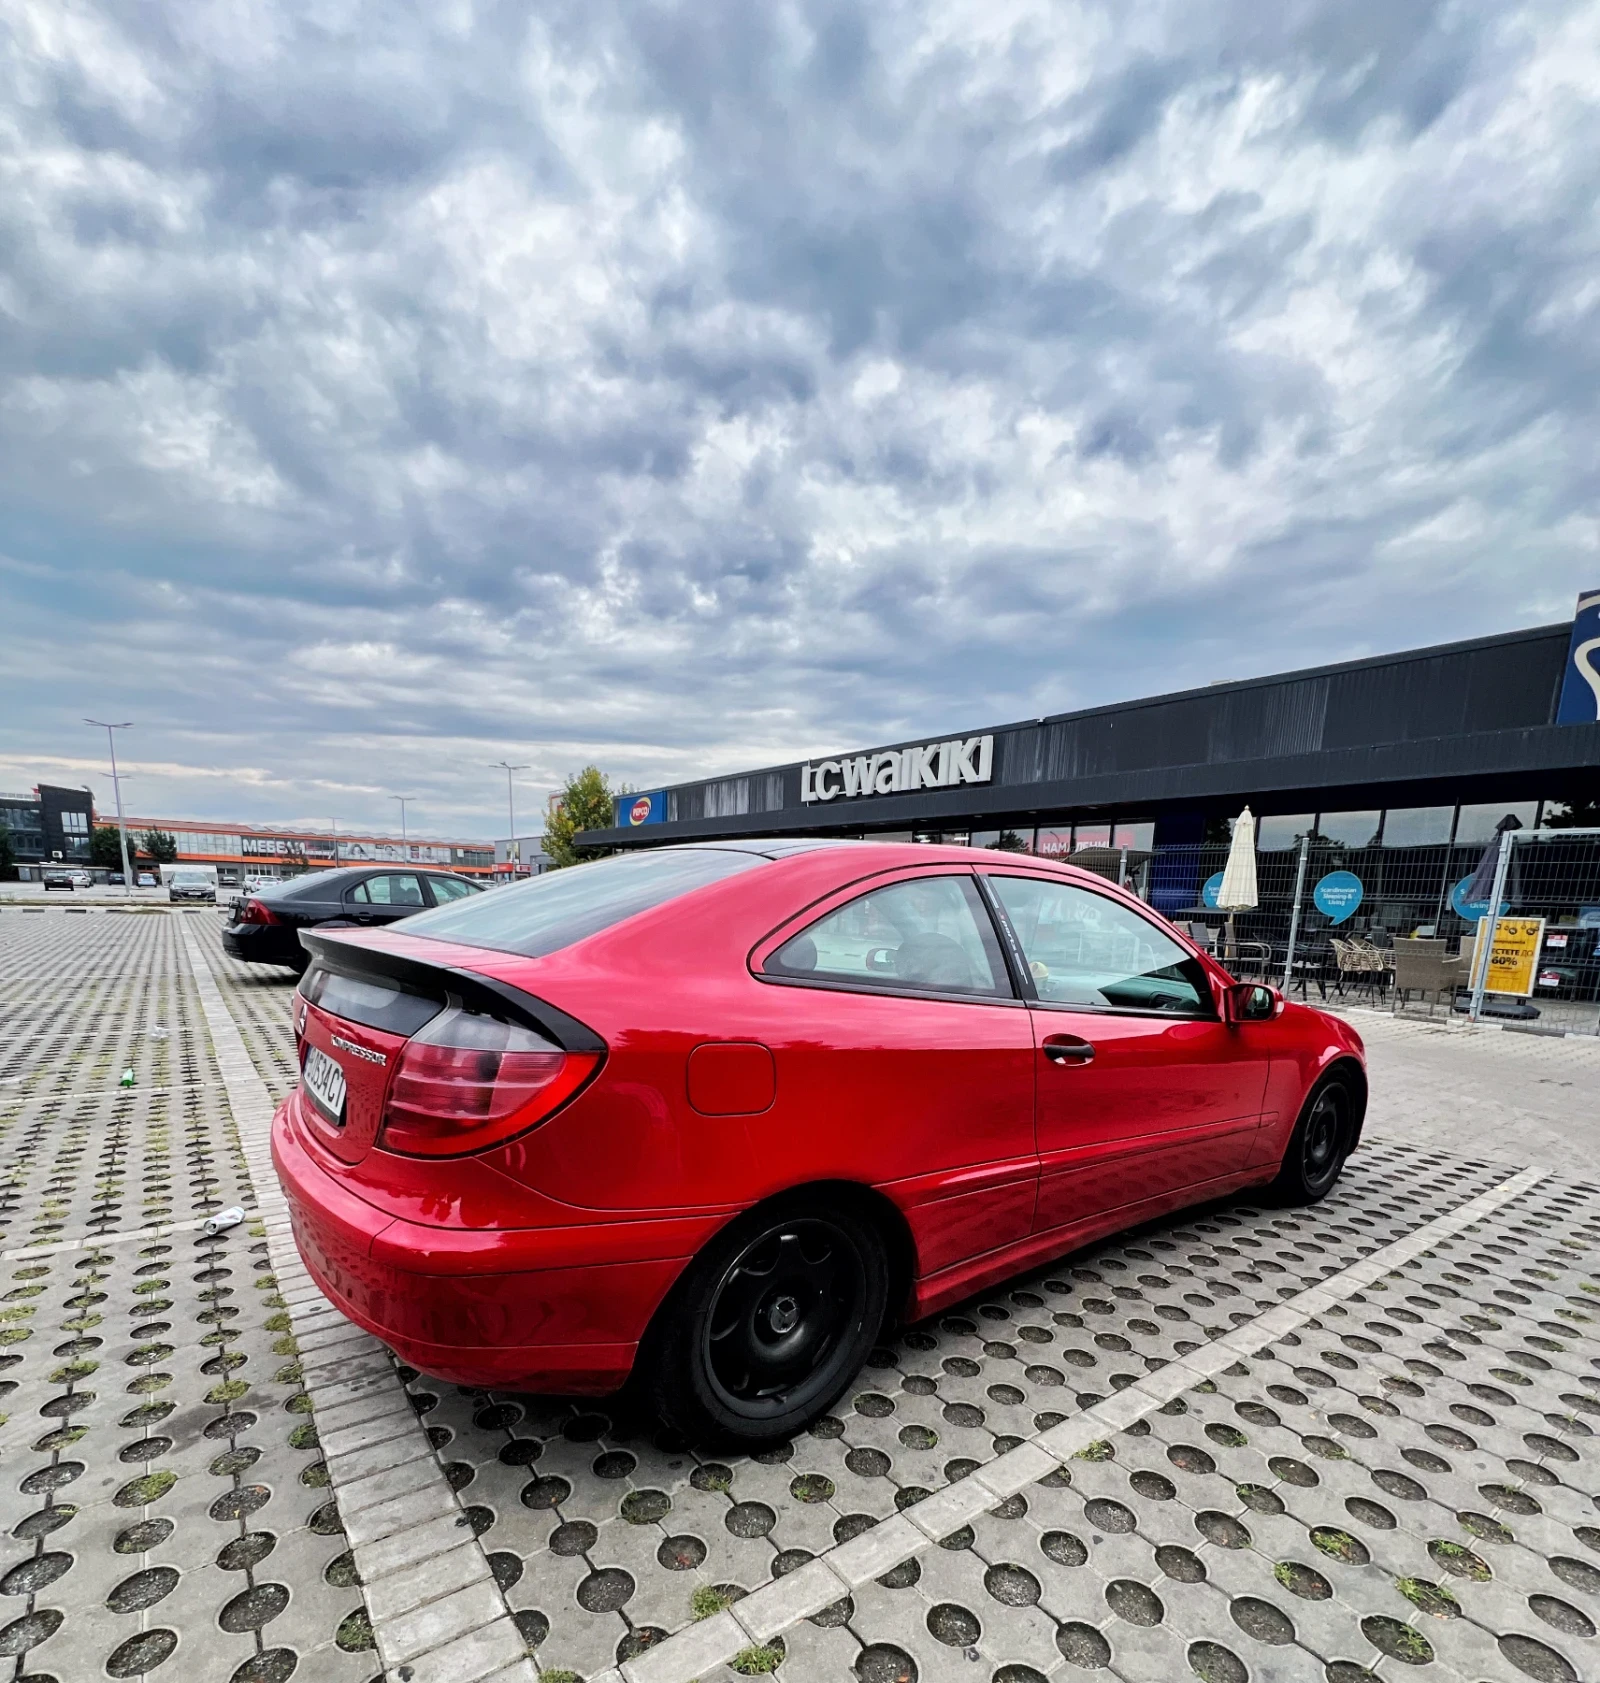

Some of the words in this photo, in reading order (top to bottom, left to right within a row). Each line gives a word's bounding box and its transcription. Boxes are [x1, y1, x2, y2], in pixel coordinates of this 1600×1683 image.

[801, 761, 840, 801] LC
[632, 806, 648, 817] PEPCO
[1042, 839, 1110, 854] НАМЛЕНИ
[1322, 893, 1347, 901] Sleeping
[1328, 899, 1346, 907] Living
[1490, 948, 1520, 956] ЕСТЕТЕ
[1491, 956, 1518, 966] 60%
